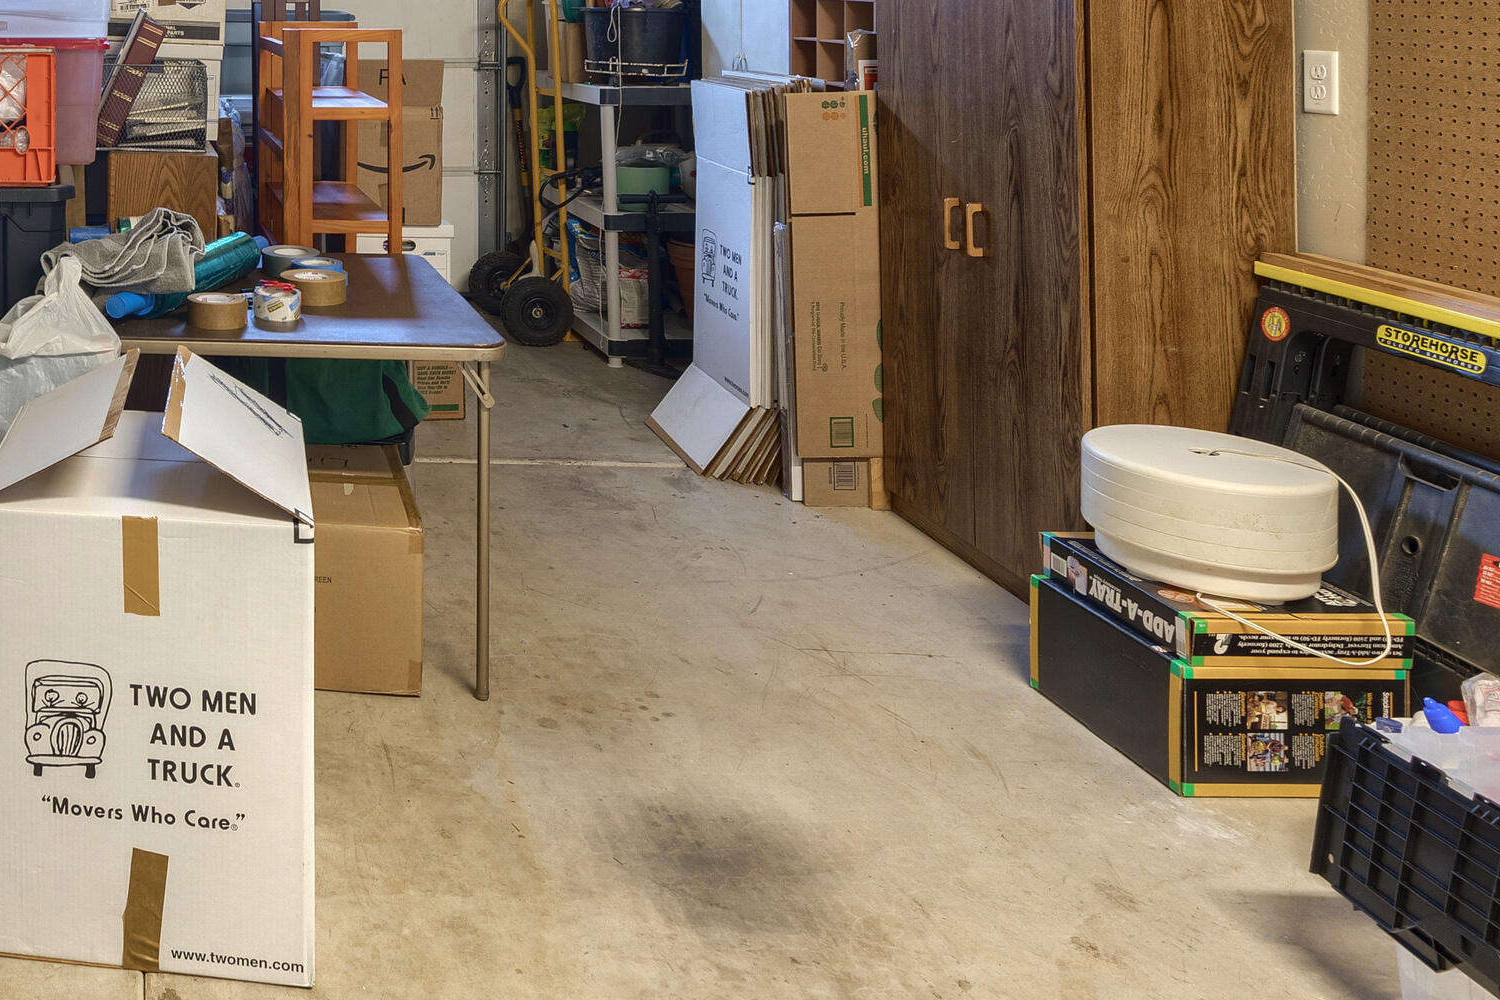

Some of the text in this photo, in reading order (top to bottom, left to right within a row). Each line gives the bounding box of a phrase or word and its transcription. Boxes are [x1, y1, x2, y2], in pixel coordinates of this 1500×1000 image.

[861, 127, 870, 174] uhaul.com
[1380, 338, 1481, 372] FOLDING SAWHORSE
[1384, 326, 1478, 364] STOREHORSE
[129, 684, 257, 715] TWO MEN
[149, 723, 236, 751] AND A
[131, 804, 176, 825] Who
[171, 948, 305, 975] www.twomen.com
